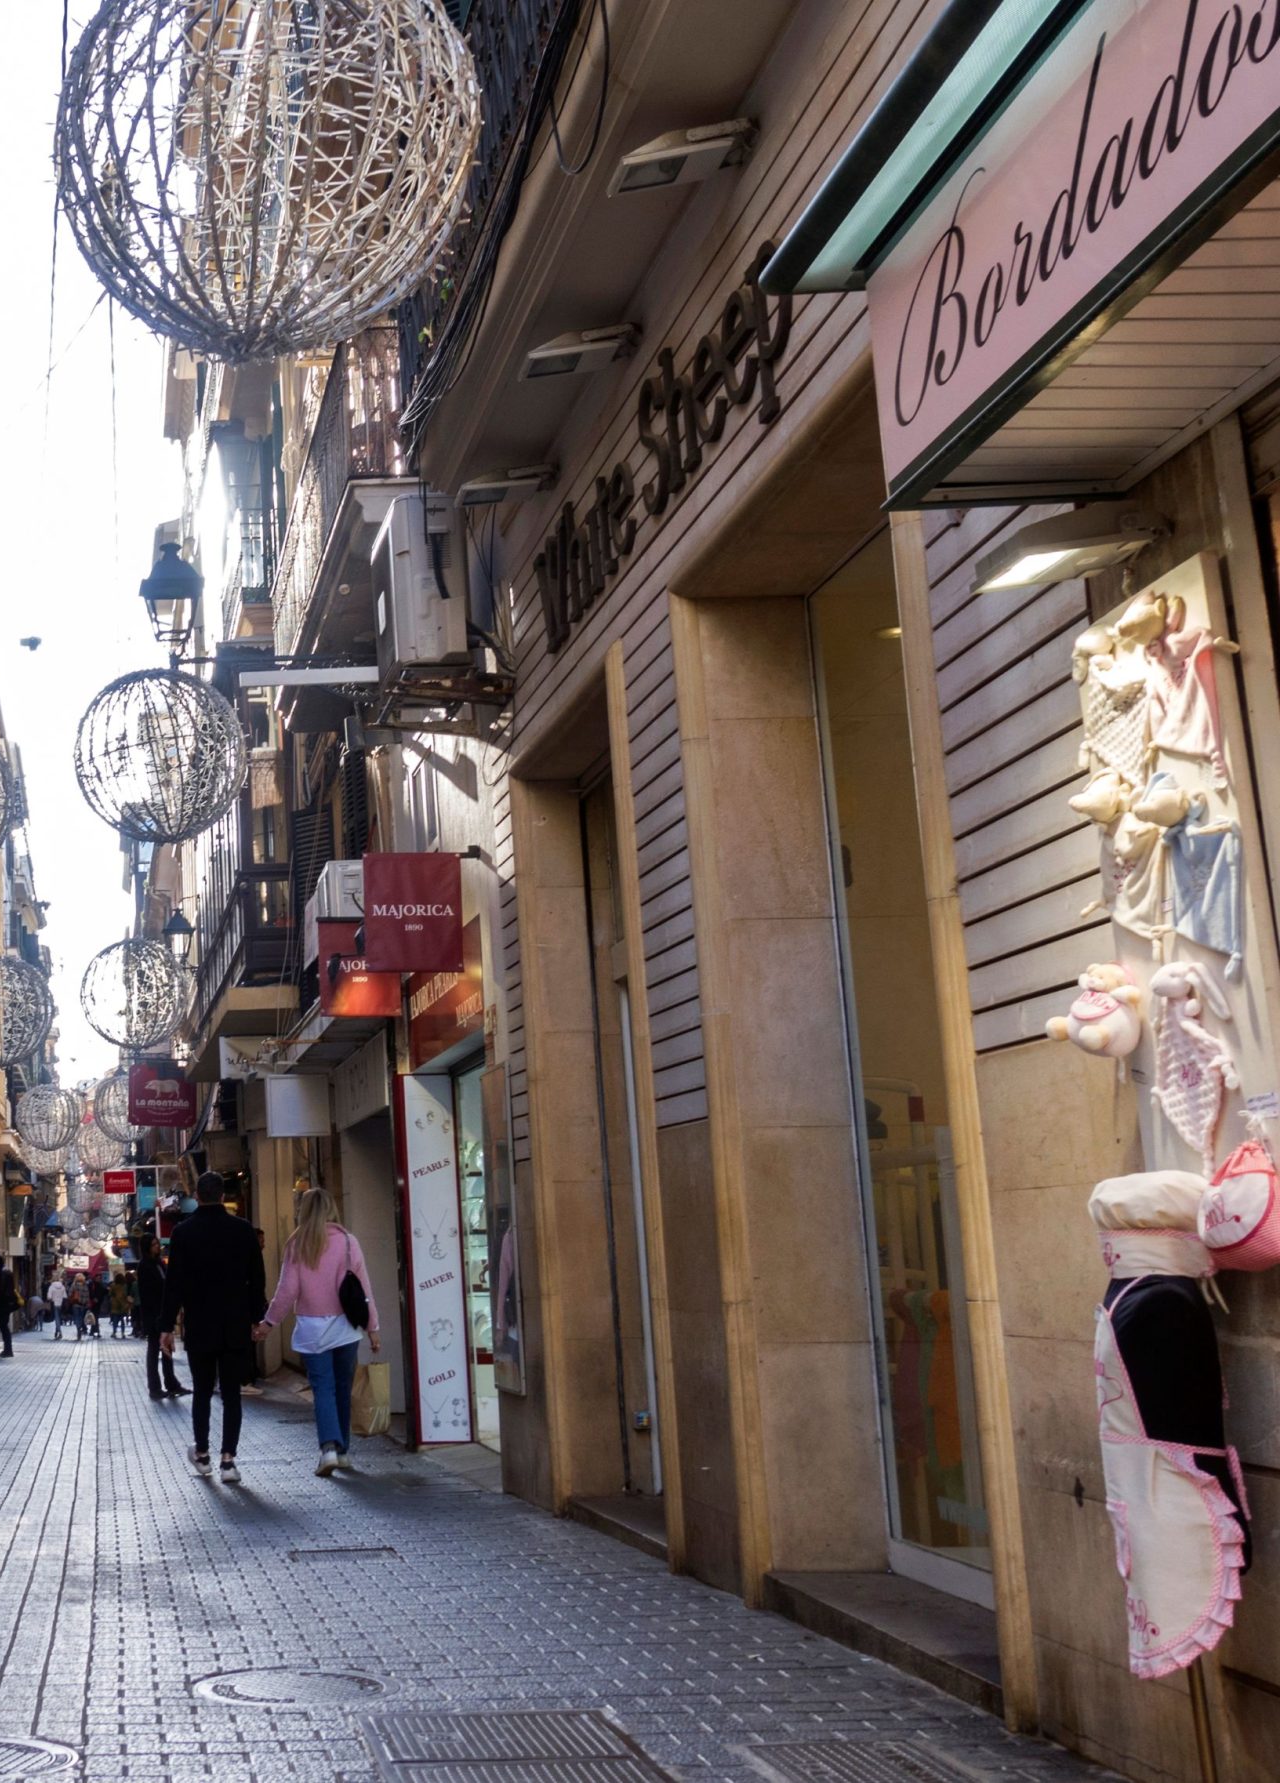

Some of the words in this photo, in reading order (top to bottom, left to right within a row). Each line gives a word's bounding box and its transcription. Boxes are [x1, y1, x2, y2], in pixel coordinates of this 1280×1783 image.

[533, 460, 637, 654] White
[638, 238, 793, 516] Sheep
[372, 904, 455, 919] MAJORICA
[404, 923, 423, 931] 1890
[135, 1098, 147, 1106] LA
[412, 1157, 451, 1179] PEARLS
[418, 1271, 455, 1292] SILVER
[427, 1368, 457, 1387] GOLD
